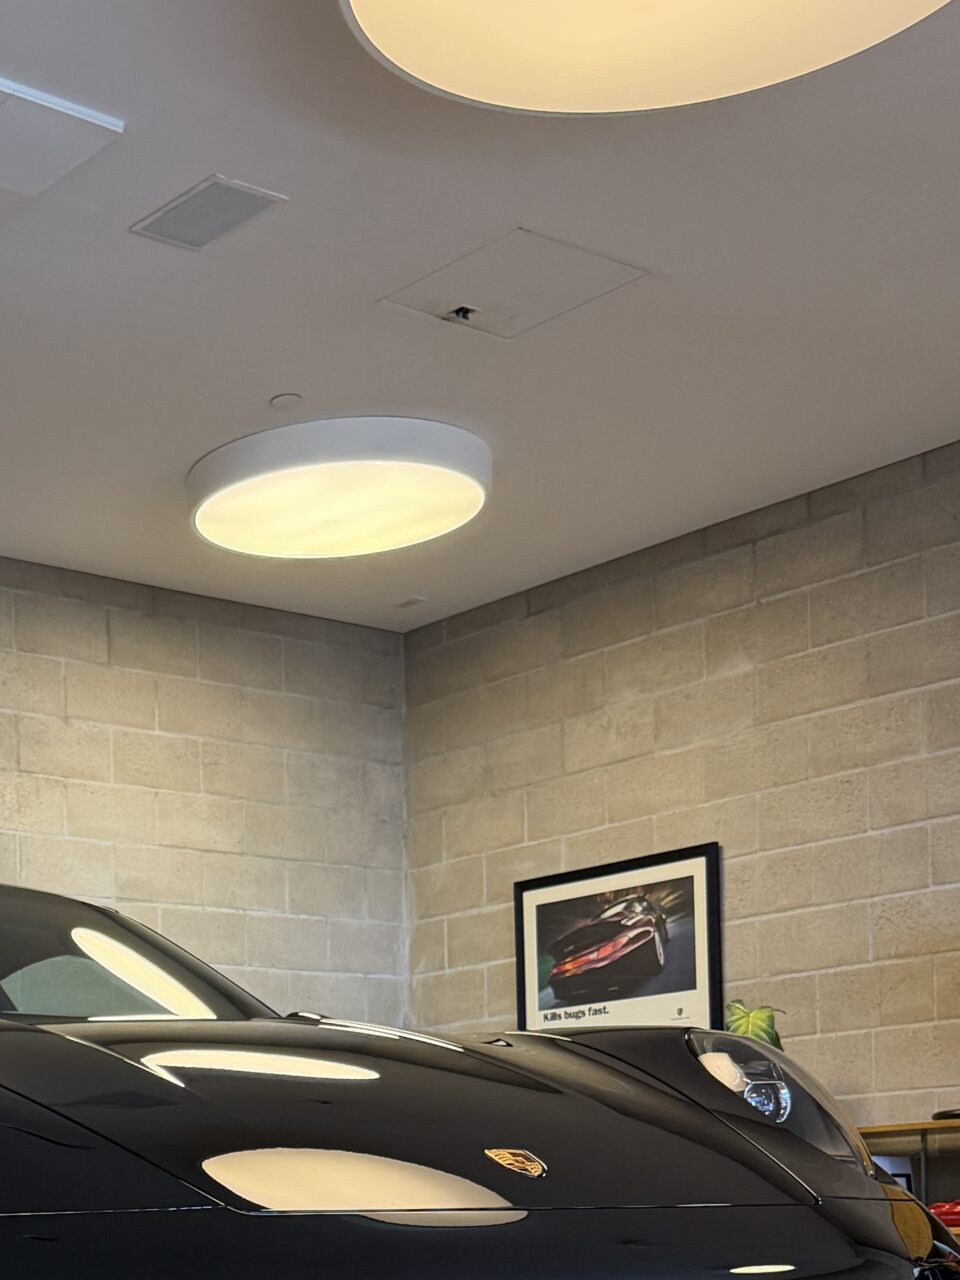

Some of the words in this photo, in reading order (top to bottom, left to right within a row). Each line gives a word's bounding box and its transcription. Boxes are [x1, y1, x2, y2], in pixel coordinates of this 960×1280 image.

[543, 1011, 562, 1022] Kills
[564, 1009, 586, 1020] bugs
[588, 1005, 609, 1016] fast.
